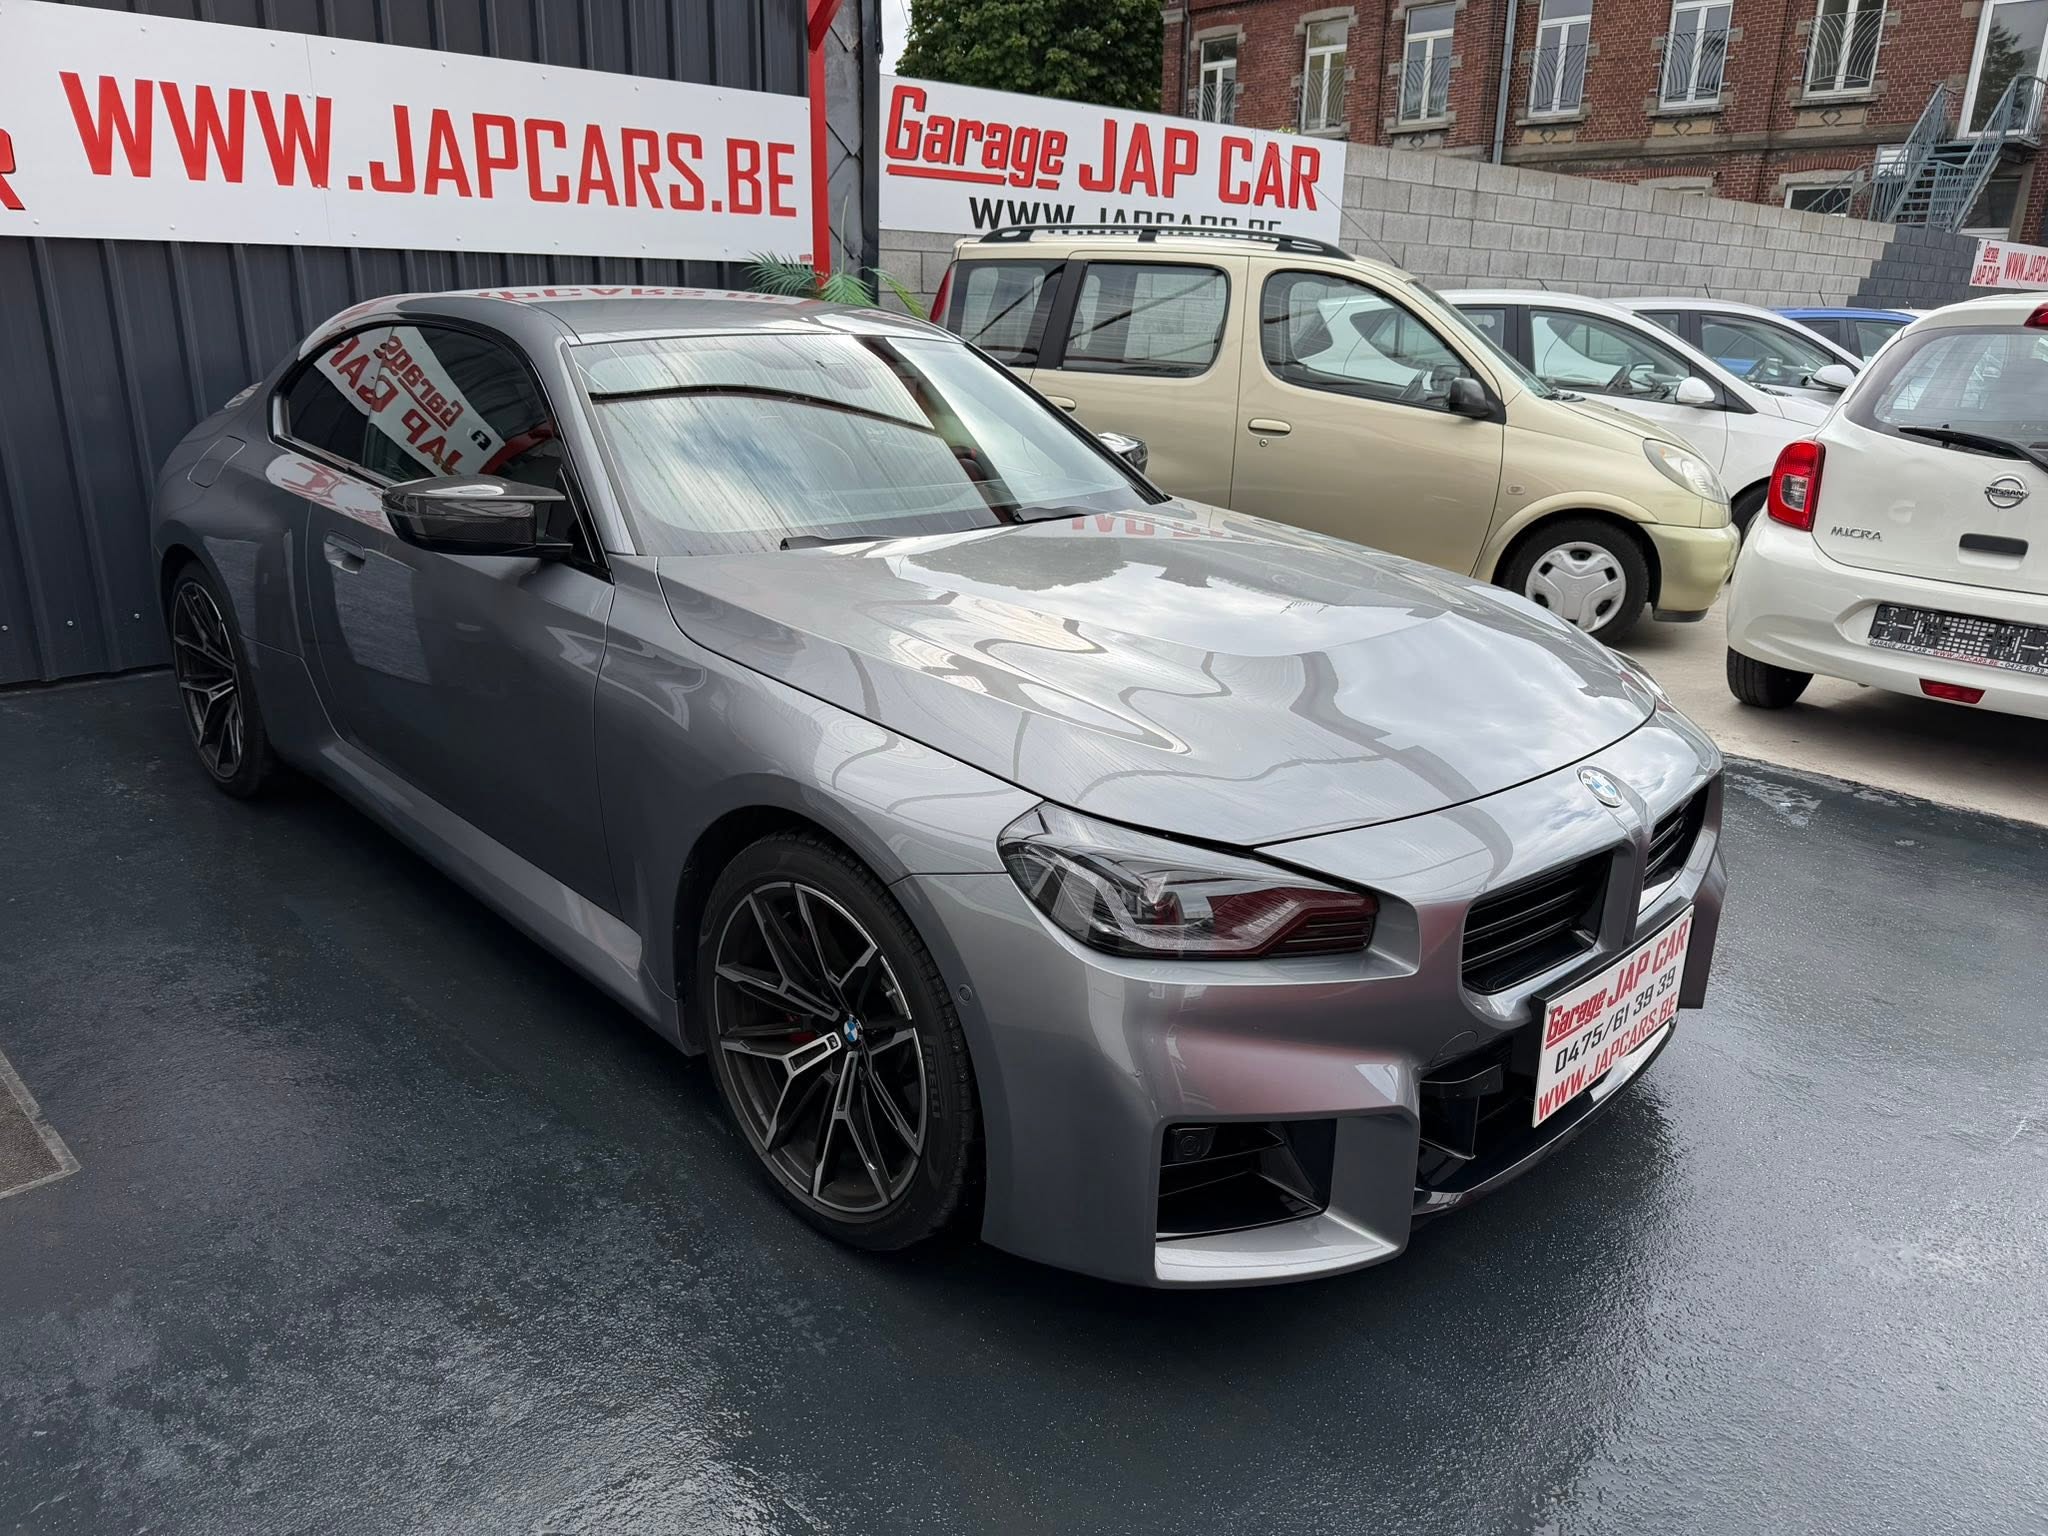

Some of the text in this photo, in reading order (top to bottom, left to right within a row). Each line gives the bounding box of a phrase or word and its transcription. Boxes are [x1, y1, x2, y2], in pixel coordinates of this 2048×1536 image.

[59, 72, 797, 218] WWW.JAPCARS.BE
[884, 85, 1320, 211] Garage JAP CAR
[1830, 526, 1882, 542] MICRA
[1987, 487, 2024, 497] NISSAN
[1546, 919, 1688, 1048] Garage JAP CAR
[1554, 966, 1677, 1075] 0475/61 39 39
[1538, 991, 1677, 1121] WWW.JAPCARS.BE
